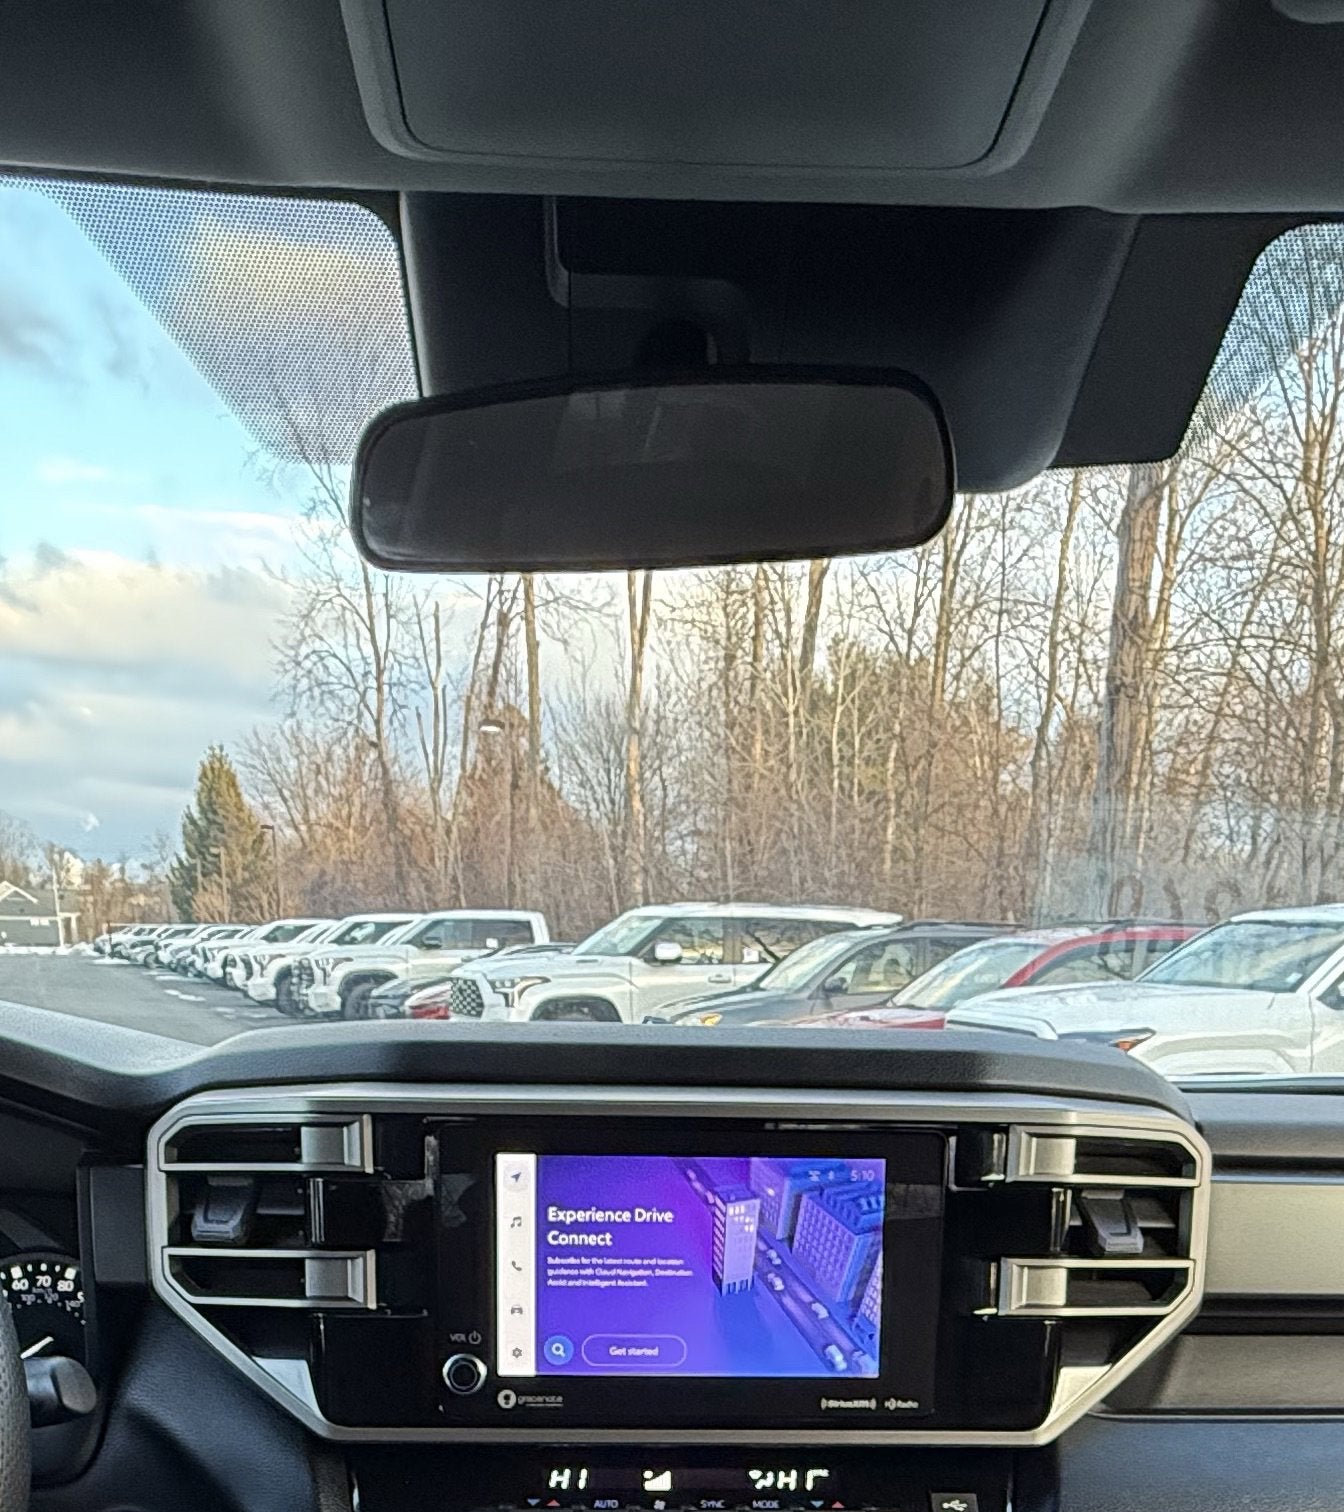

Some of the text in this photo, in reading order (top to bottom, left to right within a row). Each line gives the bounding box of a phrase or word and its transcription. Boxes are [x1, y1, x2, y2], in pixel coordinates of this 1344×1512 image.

[850, 1169, 875, 1182] 5:10
[547, 1206, 674, 1225] Experience Drive
[547, 1230, 613, 1246] Connect
[11, 1278, 29, 1291] 60
[35, 1275, 52, 1287] 70
[56, 1279, 74, 1292] 80
[609, 1346, 626, 1356] Get
[549, 1468, 588, 1489] HI
[593, 1499, 619, 1509] AUTO
[700, 1499, 726, 1509] SYNC
[752, 1499, 780, 1509] MODE
